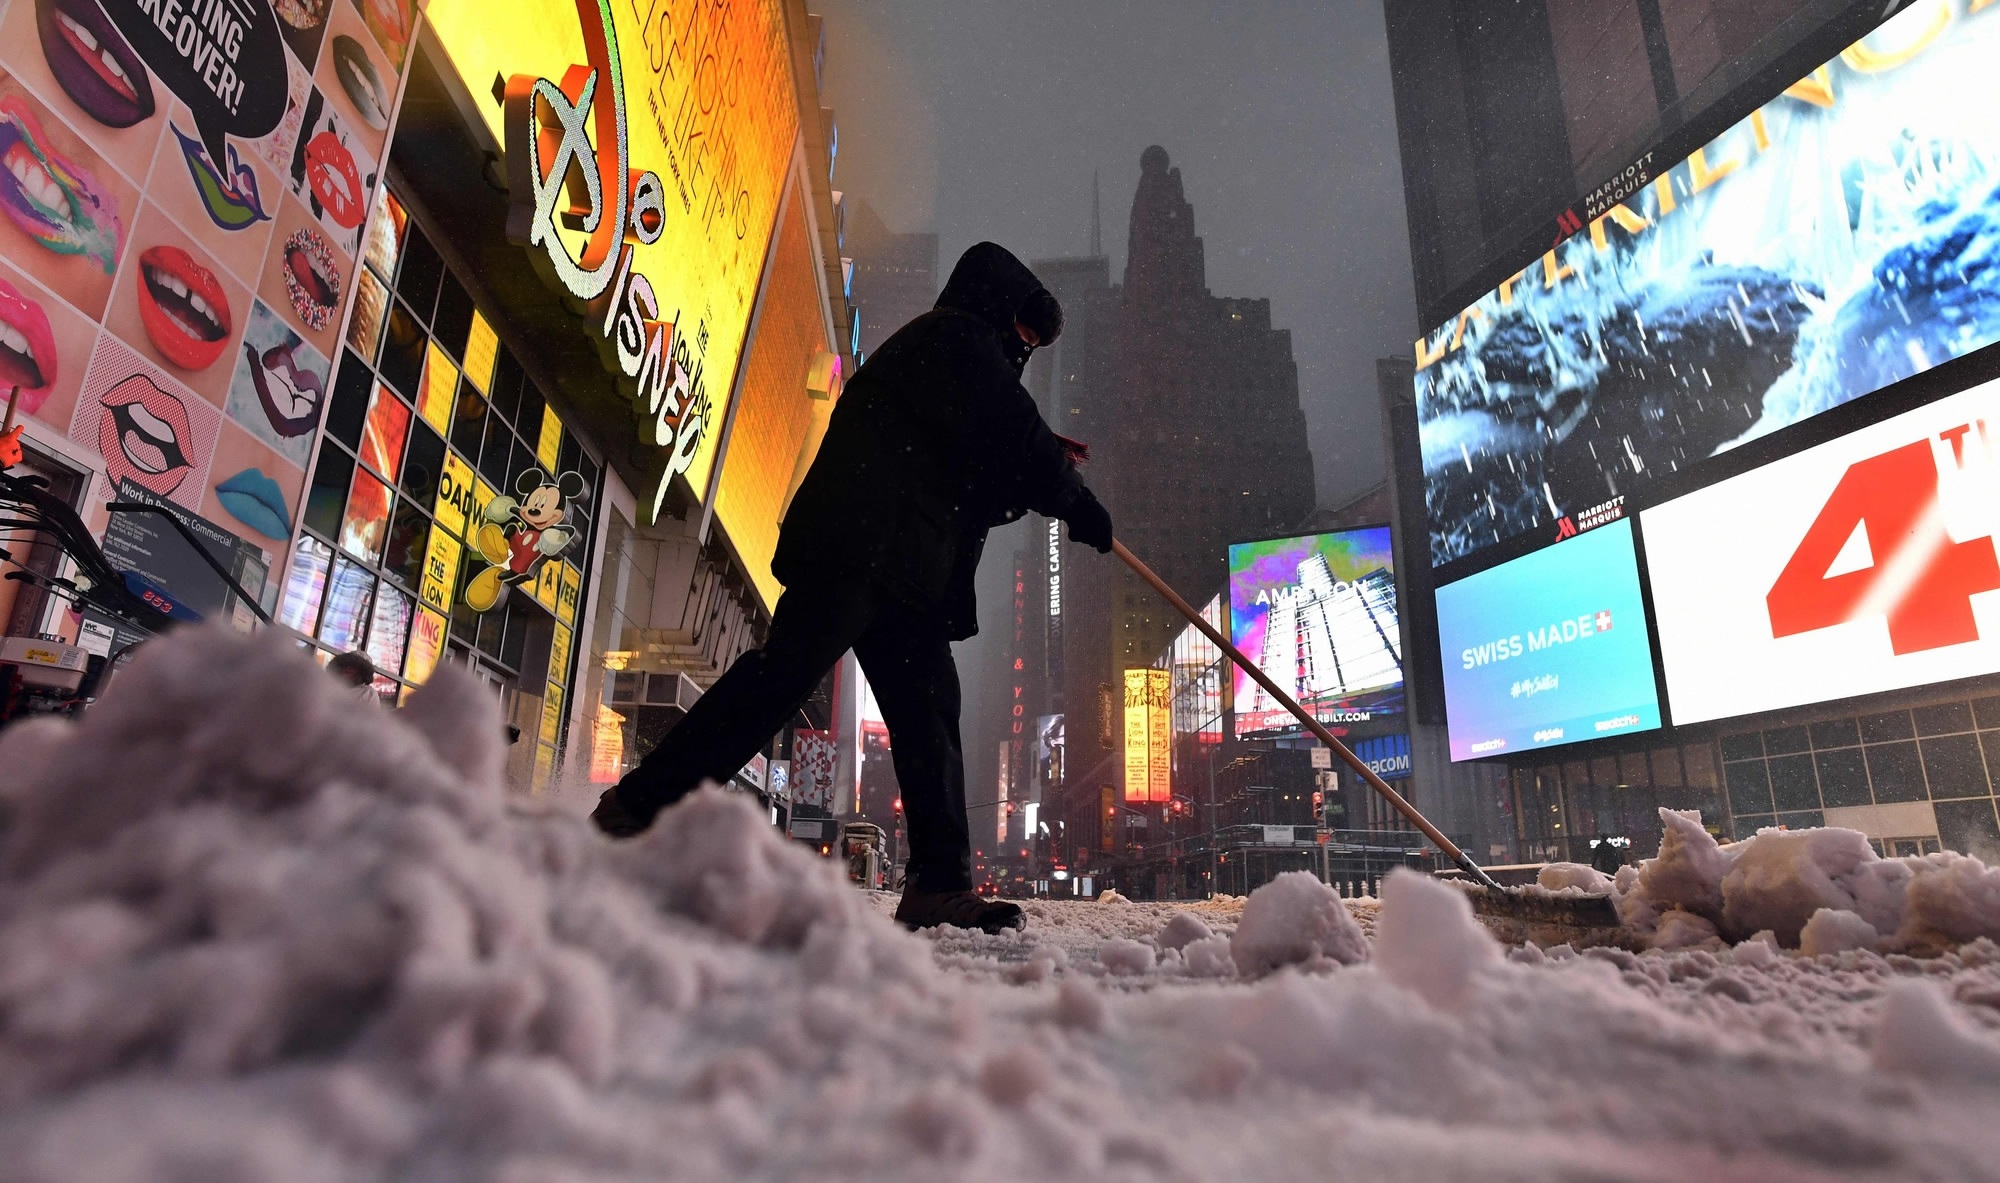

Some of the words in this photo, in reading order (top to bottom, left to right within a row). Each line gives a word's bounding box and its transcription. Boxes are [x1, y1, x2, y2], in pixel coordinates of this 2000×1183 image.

[137, 0, 245, 116] KEOVER!
[631, 0, 681, 108] LSE
[674, 84, 710, 200] LIKE
[684, 0, 750, 240] NOTHING
[648, 88, 658, 118] THE
[656, 115, 669, 148] NEW
[668, 146, 681, 186] YORK
[679, 179, 691, 215] TIMES
[1585, 152, 1653, 206] MARRIOTT
[1587, 171, 1648, 219] MARQUIS
[698, 318, 709, 351] THE
[121, 482, 144, 504] Work
[145, 495, 154, 507] in
[155, 500, 191, 527] Pess:
[190, 517, 233, 548] Commercial
[1578, 495, 1624, 521] MARRIOTT
[1579, 507, 1621, 531] MARQUIS
[1049, 518, 1060, 572] CAPITAL
[429, 556, 445, 579] THE
[421, 575, 444, 607] LION
[544, 566, 553, 591] A
[556, 572, 578, 611] WEE
[84, 622, 98, 632] NYC
[1462, 634, 1524, 670] SWISS
[1527, 614, 1594, 652] MADE
[1013, 658, 1024, 670] &
[1128, 727, 1144, 737] LION
[1130, 721, 1141, 729] THE
[1263, 711, 1371, 728] ONEVARBILT.COM
[1127, 737, 1146, 749] KING
